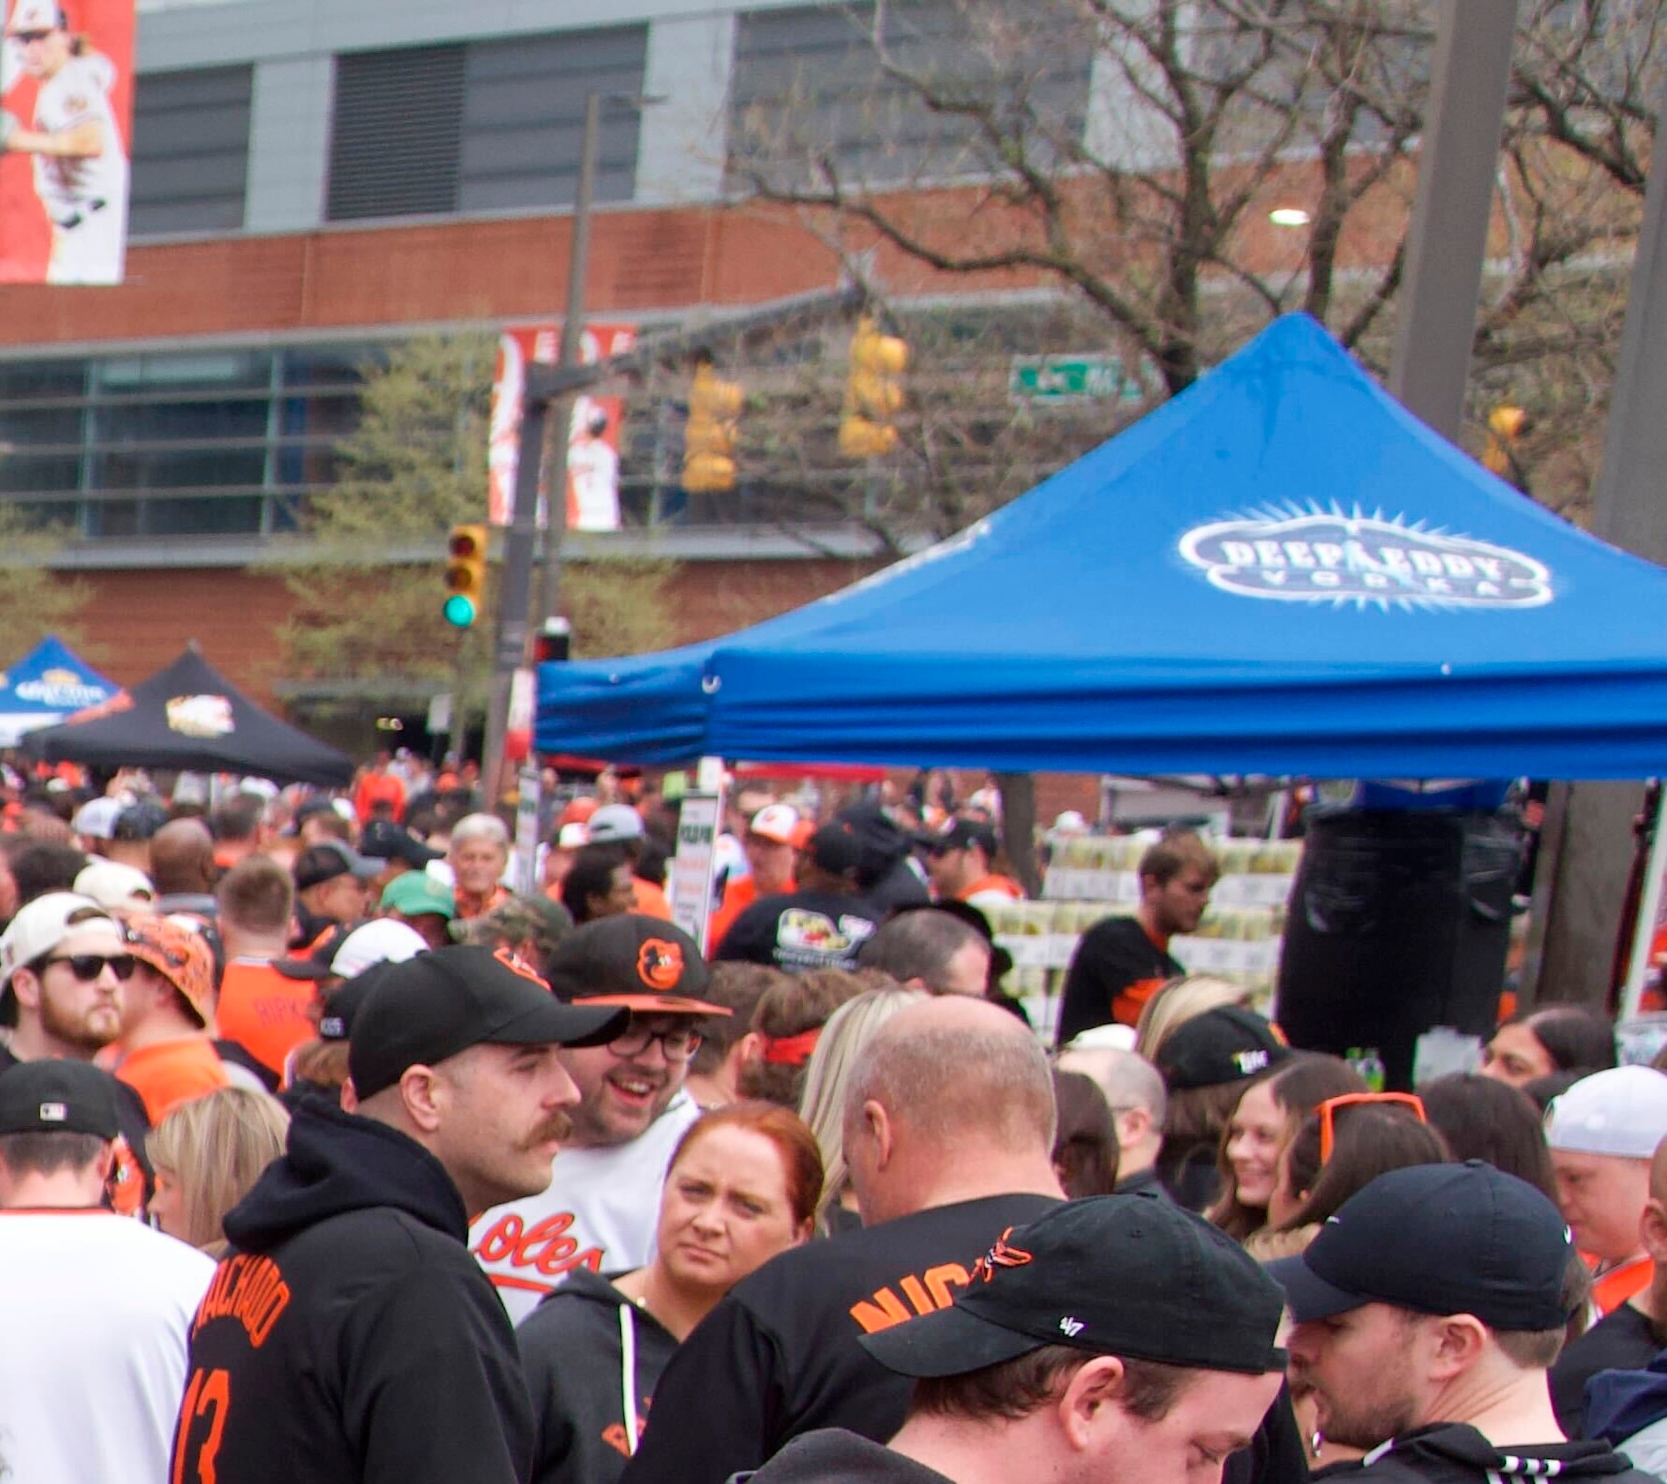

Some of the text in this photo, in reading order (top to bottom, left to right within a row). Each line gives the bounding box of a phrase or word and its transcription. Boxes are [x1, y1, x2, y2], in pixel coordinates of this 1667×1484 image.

[1220, 540, 1499, 582] DEEP EDDY
[1264, 569, 1501, 595] VODKA
